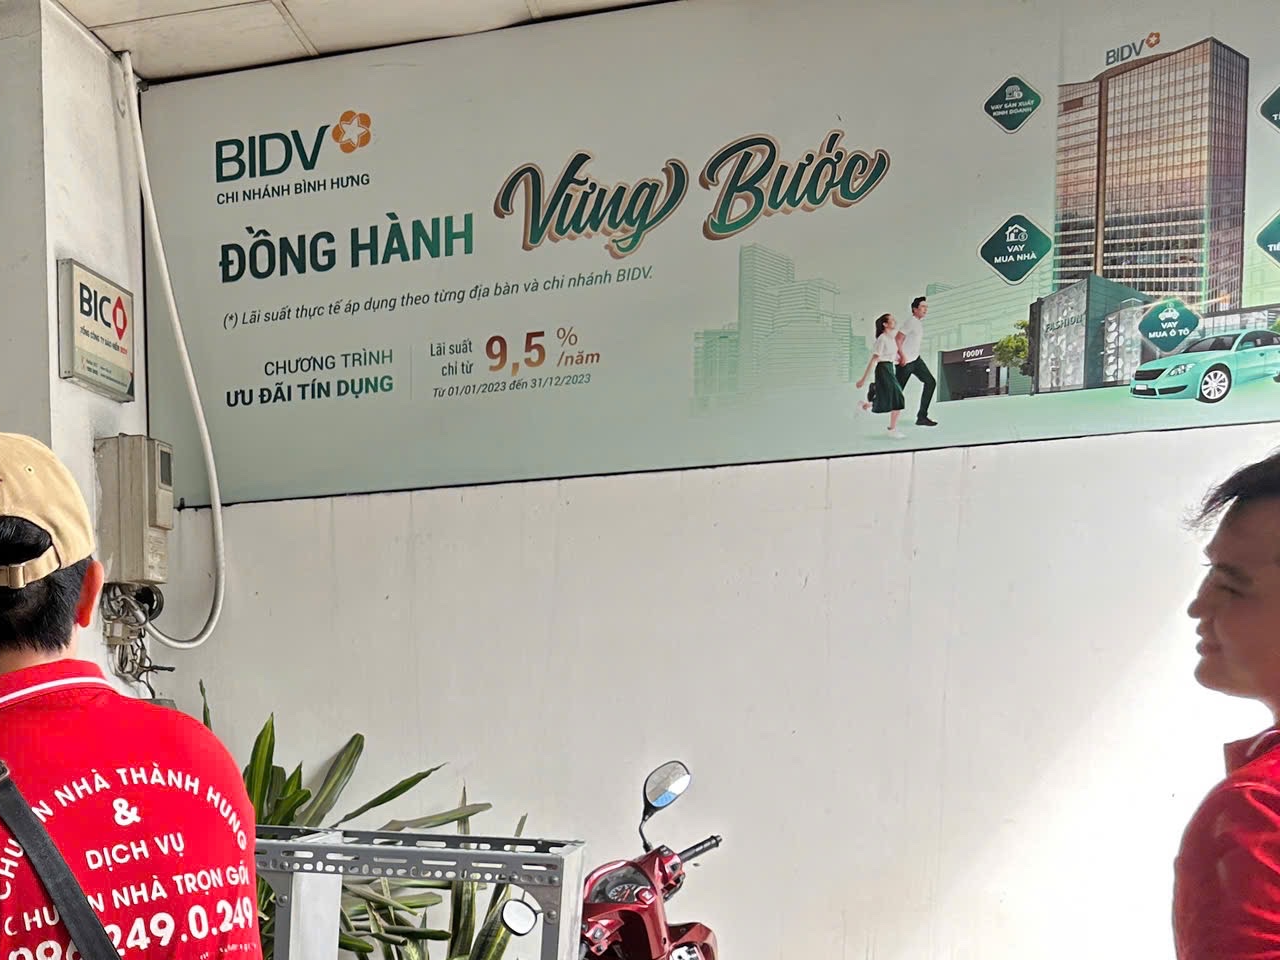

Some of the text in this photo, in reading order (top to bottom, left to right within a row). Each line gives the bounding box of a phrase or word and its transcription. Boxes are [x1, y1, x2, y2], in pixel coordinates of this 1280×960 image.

[1106, 38, 1145, 66] BIDV
[215, 125, 330, 183] BIDV
[217, 173, 370, 205] CHI NHÁNH BÌNH HƯNG
[496, 131, 888, 256] Vững Bước
[219, 212, 473, 283] ĐỒNG HÀNH
[994, 250, 1038, 264] MUA NHÀ
[1007, 244, 1026, 254] VAY
[80, 282, 111, 329] BIC
[242, 310, 261, 325] Lãi
[263, 304, 291, 322] suất
[295, 304, 324, 320] thực
[328, 300, 344, 315] tế
[344, 299, 361, 315] áp
[364, 296, 397, 313] dụng
[401, 292, 430, 306] theo
[434, 285, 466, 303] từng
[469, 285, 490, 301] địa
[494, 282, 520, 296] bàn
[523, 280, 539, 293] và
[543, 275, 565, 290] chi
[568, 270, 612, 289] nhánh
[616, 265, 654, 283] BIDV.
[556, 326, 578, 347] %
[1045, 314, 1083, 333] FASHION
[1149, 328, 1190, 339] MUA Ô TÔ
[1161, 321, 1178, 330] VAY
[430, 338, 473, 357] Lãi suất
[485, 330, 546, 376] 9,5
[556, 350, 601, 368] /năm
[962, 348, 985, 360] FOODY
[264, 348, 393, 376] CHƯƠNG TRÌNH
[461, 360, 474, 375] từ
[226, 374, 393, 408] ƯU ĐÃI TÍN DỤNG
[433, 373, 591, 398] Từ 01/01/2023 đến 31/12/2023
[54, 768, 111, 807] NHÀ
[116, 762, 200, 795] THÀNH
[112, 798, 141, 826] &
[85, 832, 185, 872] DỊCH VỤ
[4, 860, 250, 937] CHUN NHÀ TRỌN GÓI
